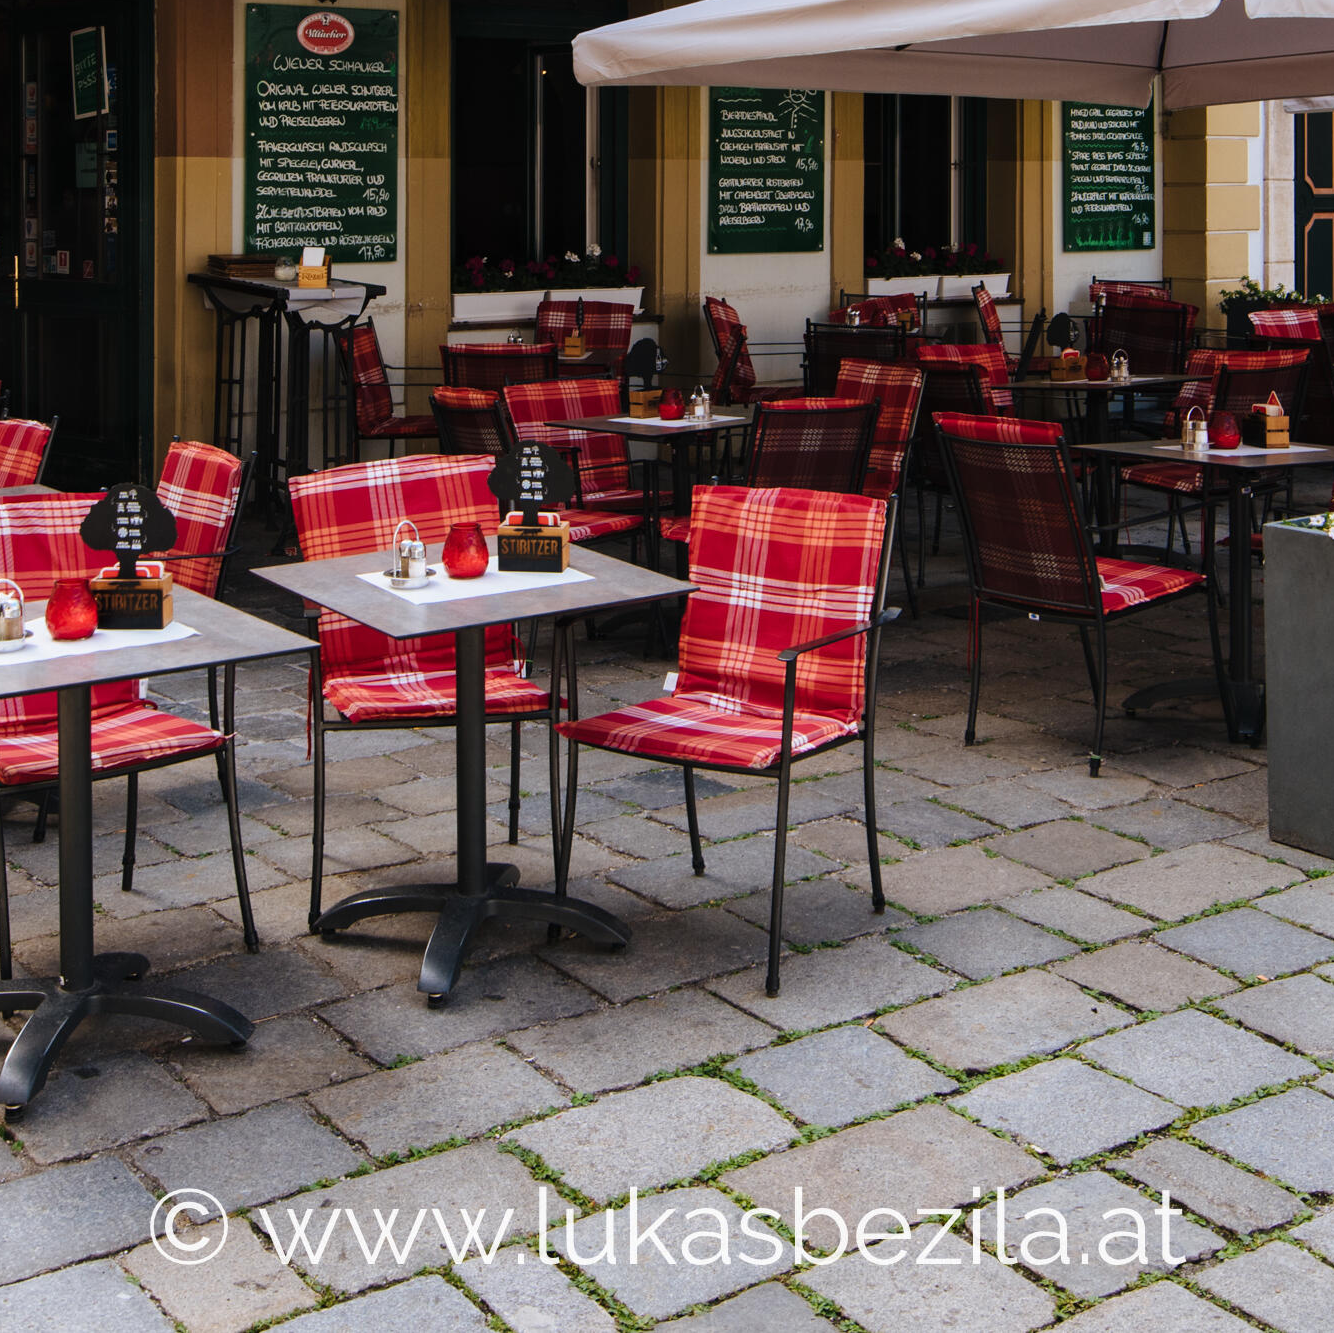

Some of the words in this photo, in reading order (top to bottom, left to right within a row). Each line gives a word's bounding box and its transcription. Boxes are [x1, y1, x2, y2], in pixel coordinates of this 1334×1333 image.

[257, 80, 309, 97] ORIGINAL
[501, 538, 559, 556] STIBITZER
[96, 593, 159, 611] STIBITZER
